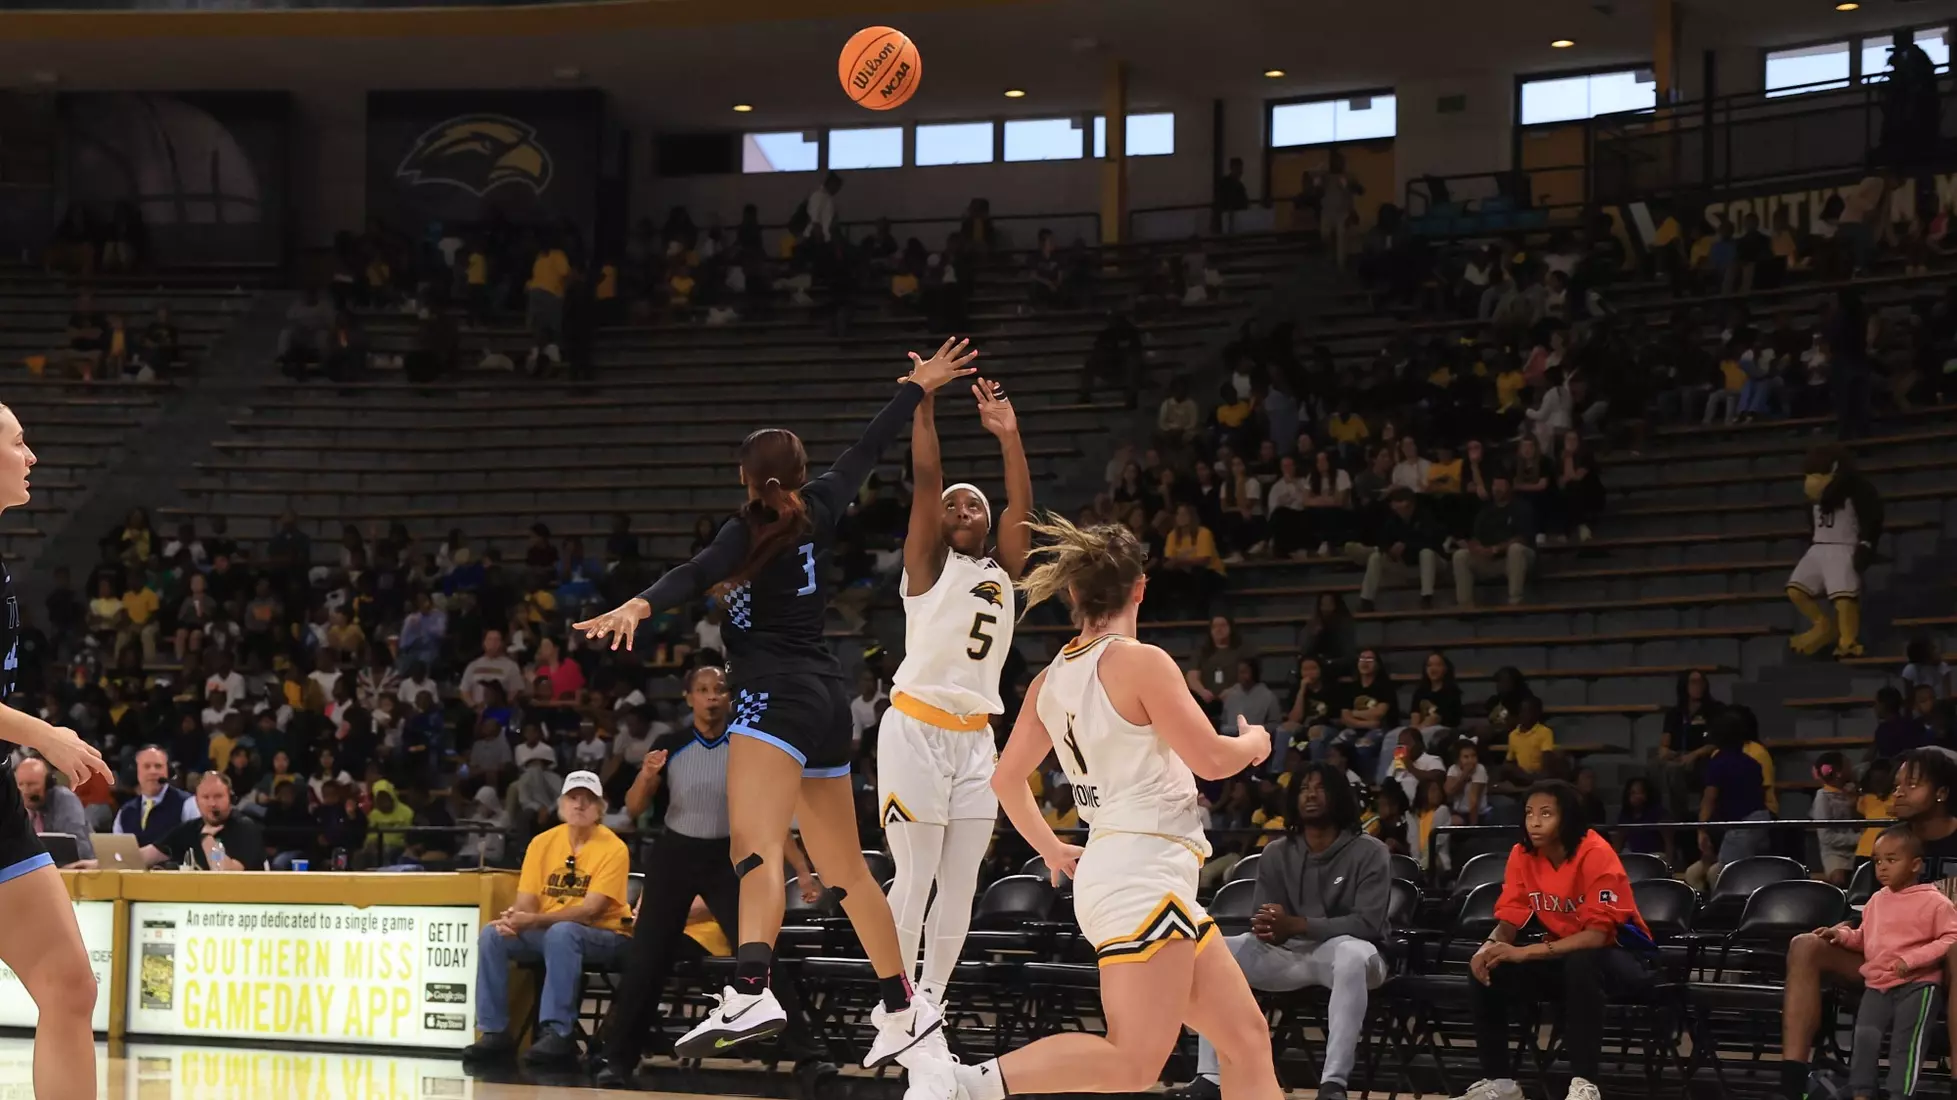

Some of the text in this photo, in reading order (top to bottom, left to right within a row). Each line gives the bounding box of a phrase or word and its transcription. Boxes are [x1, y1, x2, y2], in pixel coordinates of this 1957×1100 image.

[853, 42, 896, 89] Wilson
[880, 61, 911, 98] NCAA
[797, 542, 816, 596] 3
[966, 612, 997, 660] 5
[186, 910, 200, 927] An
[203, 912, 234, 928] entire
[238, 915, 257, 931] app
[261, 912, 316, 929] dedicated
[320, 914, 331, 929] to
[335, 918, 342, 929] a
[345, 914, 378, 934] single
[382, 917, 414, 934] game
[428, 922, 469, 943] GET IT
[185, 937, 413, 981] SOUTHERN MISS
[427, 947, 468, 968] TODAY
[183, 978, 412, 1038] GAMEDAY APP
